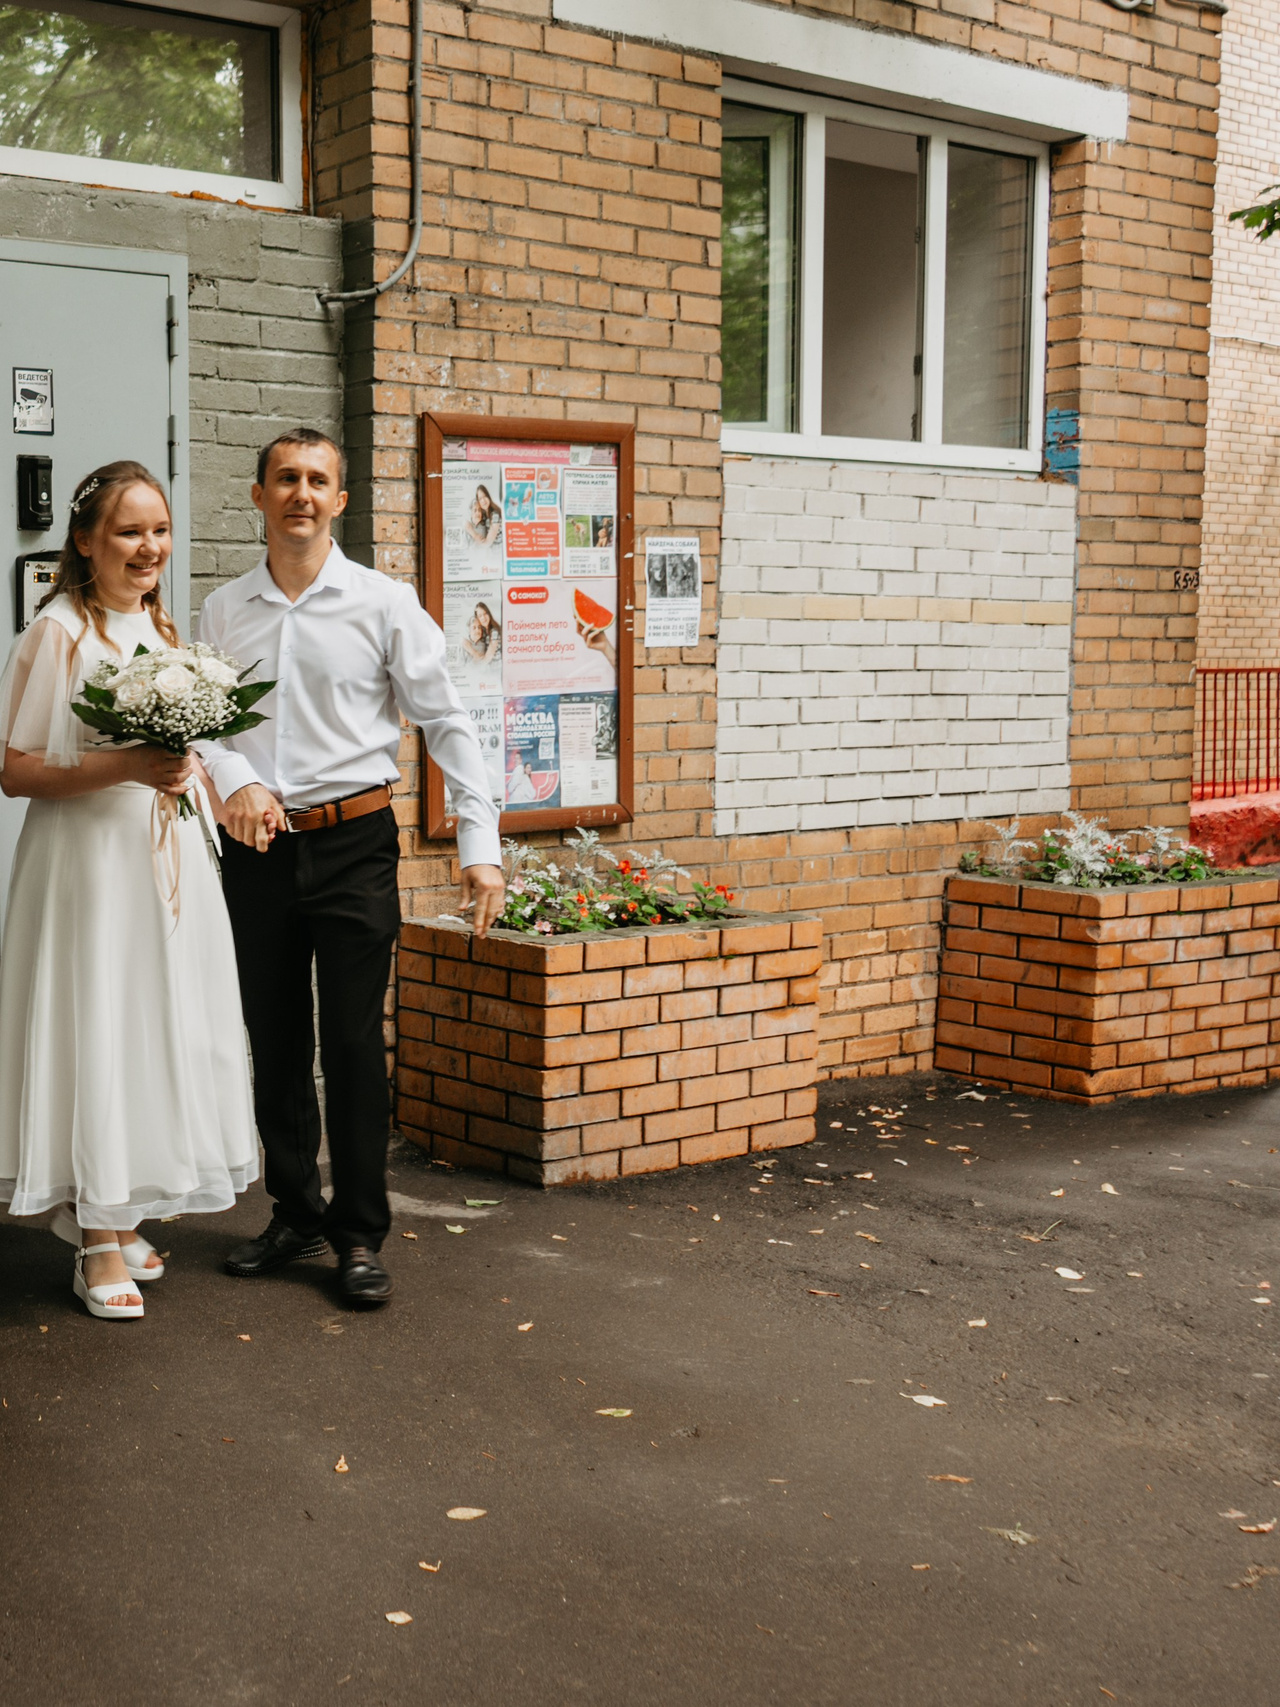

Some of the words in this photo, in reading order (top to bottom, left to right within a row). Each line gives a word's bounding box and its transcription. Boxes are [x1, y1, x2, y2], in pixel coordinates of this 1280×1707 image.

[18, 373, 48, 382] ВЕДЕТСЯ
[507, 620, 546, 631] Поймаем
[519, 633, 548, 643] дольку
[507, 645, 541, 654] сочного
[543, 642, 575, 654] арбуза
[506, 712, 554, 726] МОСКВА
